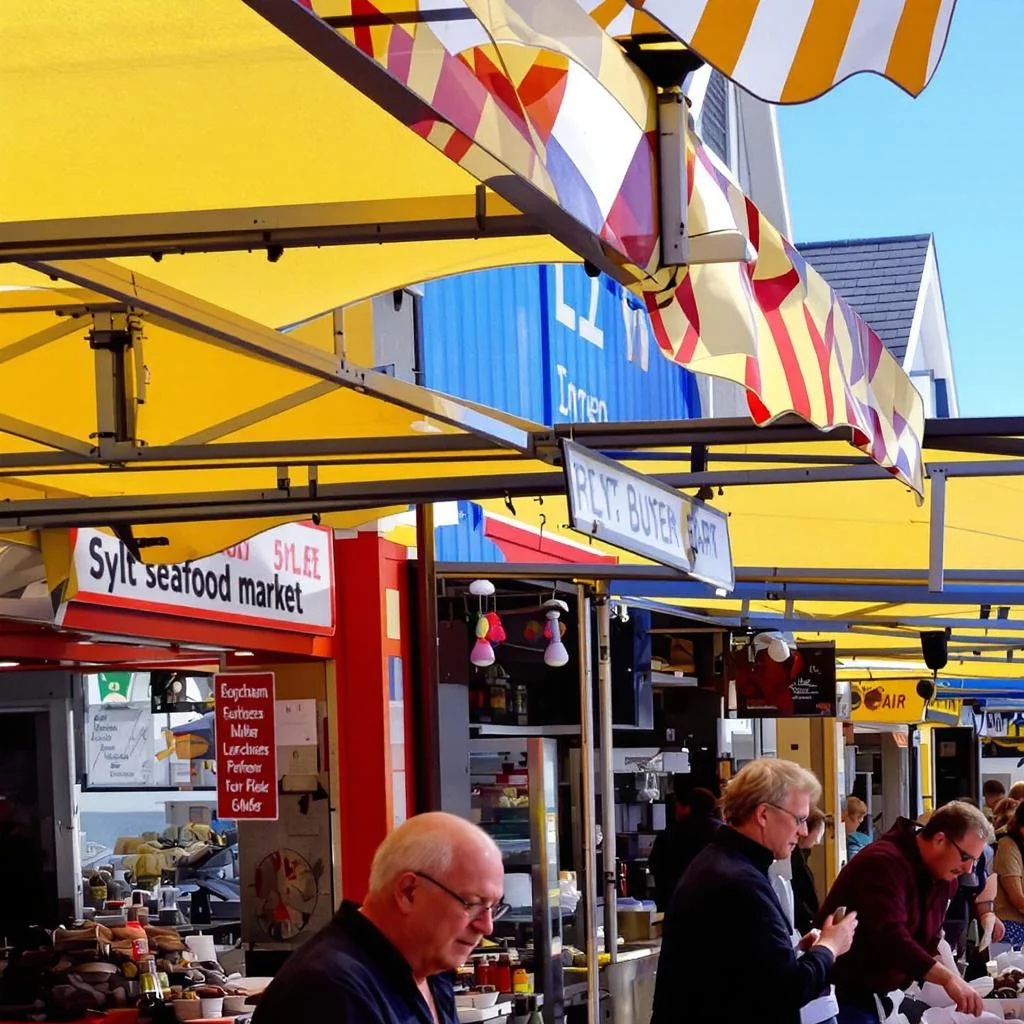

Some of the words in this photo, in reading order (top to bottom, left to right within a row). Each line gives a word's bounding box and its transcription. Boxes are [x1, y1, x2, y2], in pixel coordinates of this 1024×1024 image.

[88, 536, 137, 593] Sylt
[145, 562, 231, 602] seafood
[239, 573, 304, 615] market
